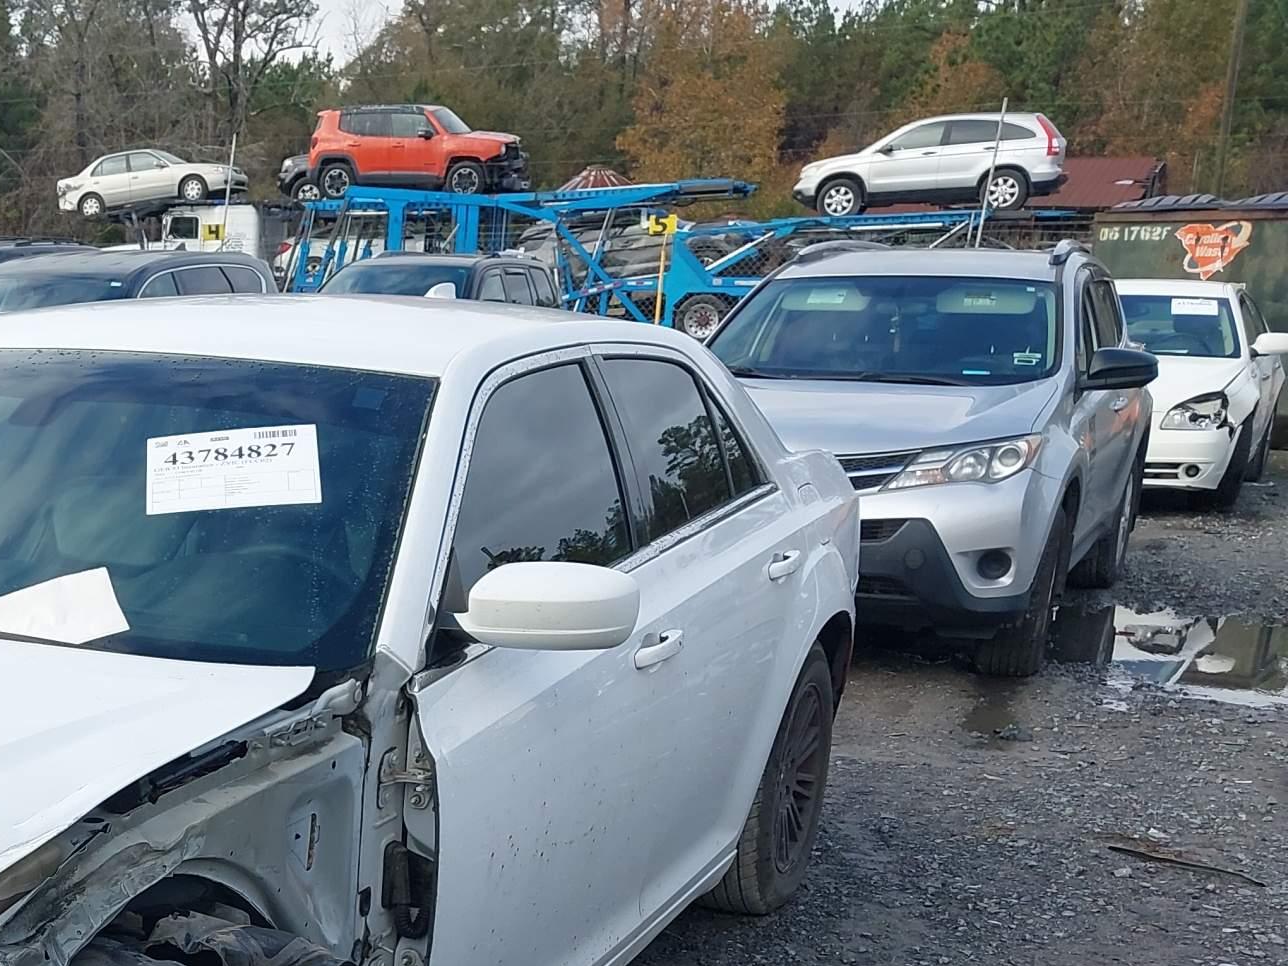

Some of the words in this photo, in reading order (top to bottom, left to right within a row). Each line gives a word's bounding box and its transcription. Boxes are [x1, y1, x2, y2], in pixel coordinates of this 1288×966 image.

[208, 224, 220, 240] 4
[652, 216, 668, 234] 5
[163, 442, 296, 466] 43784827
